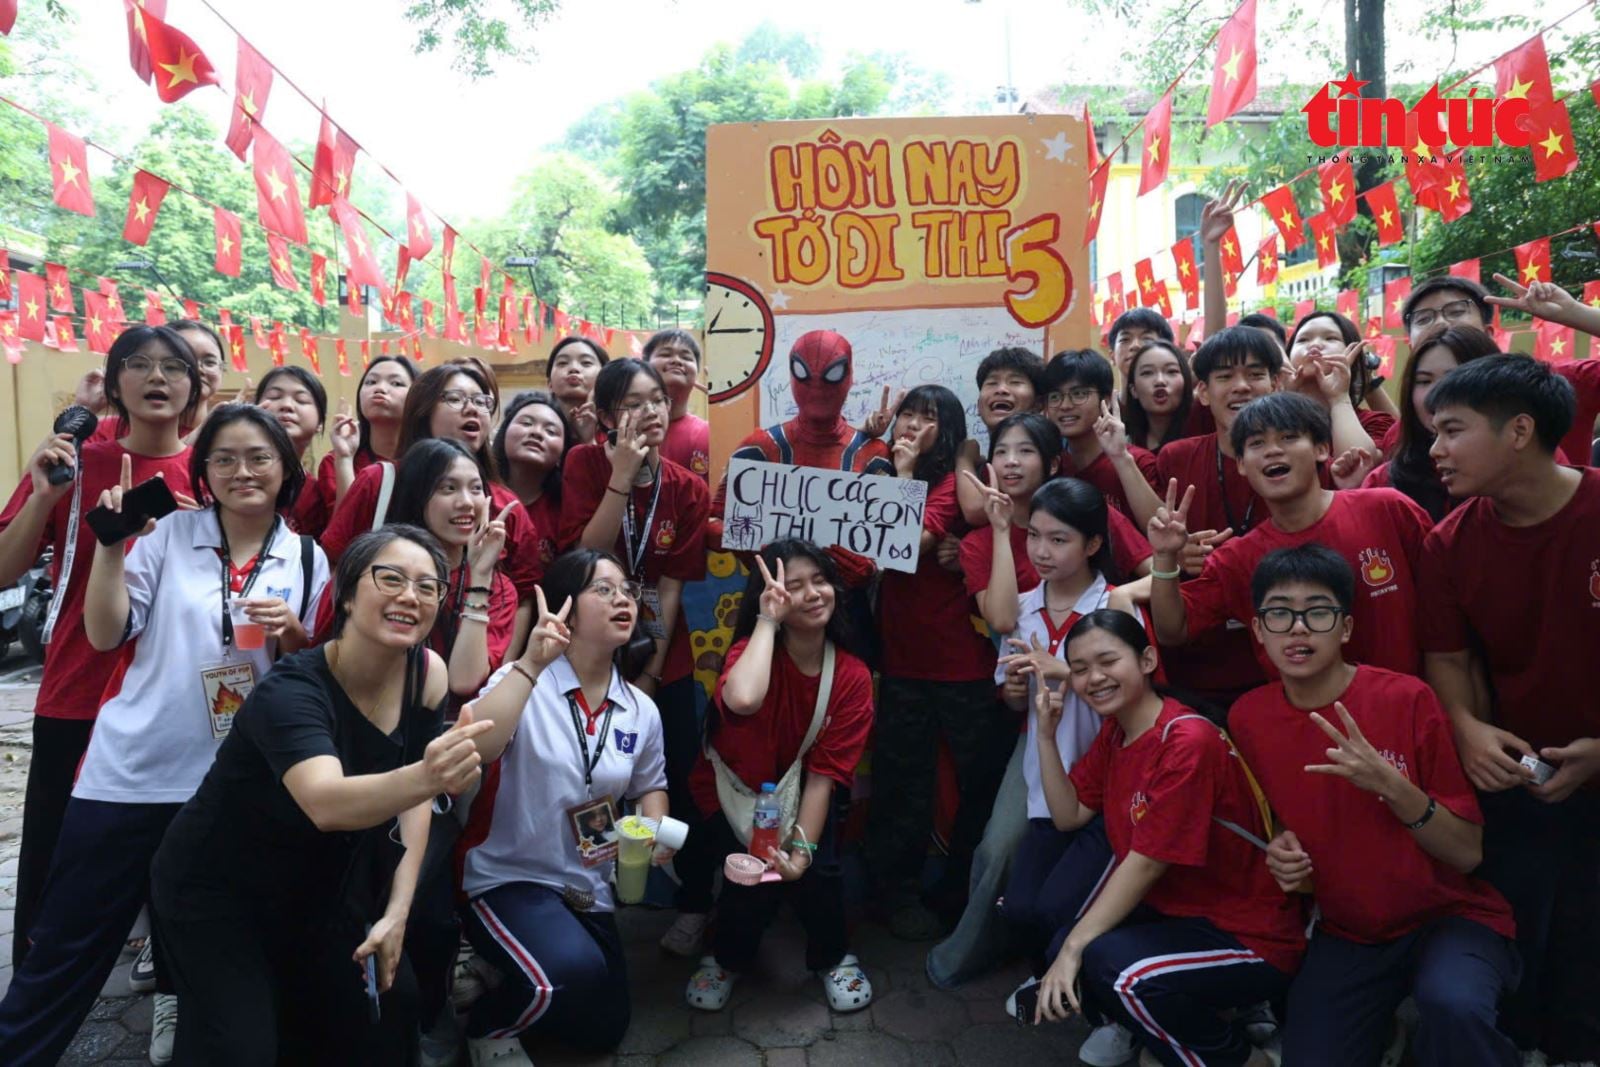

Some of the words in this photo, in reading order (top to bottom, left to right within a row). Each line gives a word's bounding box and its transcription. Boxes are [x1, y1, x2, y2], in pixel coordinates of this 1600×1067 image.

[770, 128, 896, 212] HÔM
[903, 140, 1020, 208] NAY
[754, 207, 830, 285] TỚ
[831, 210, 904, 289] ĐI
[911, 209, 1009, 278] THI
[1003, 212, 1074, 329] 5
[733, 465, 822, 516] CHÚC
[769, 511, 814, 541] THI
